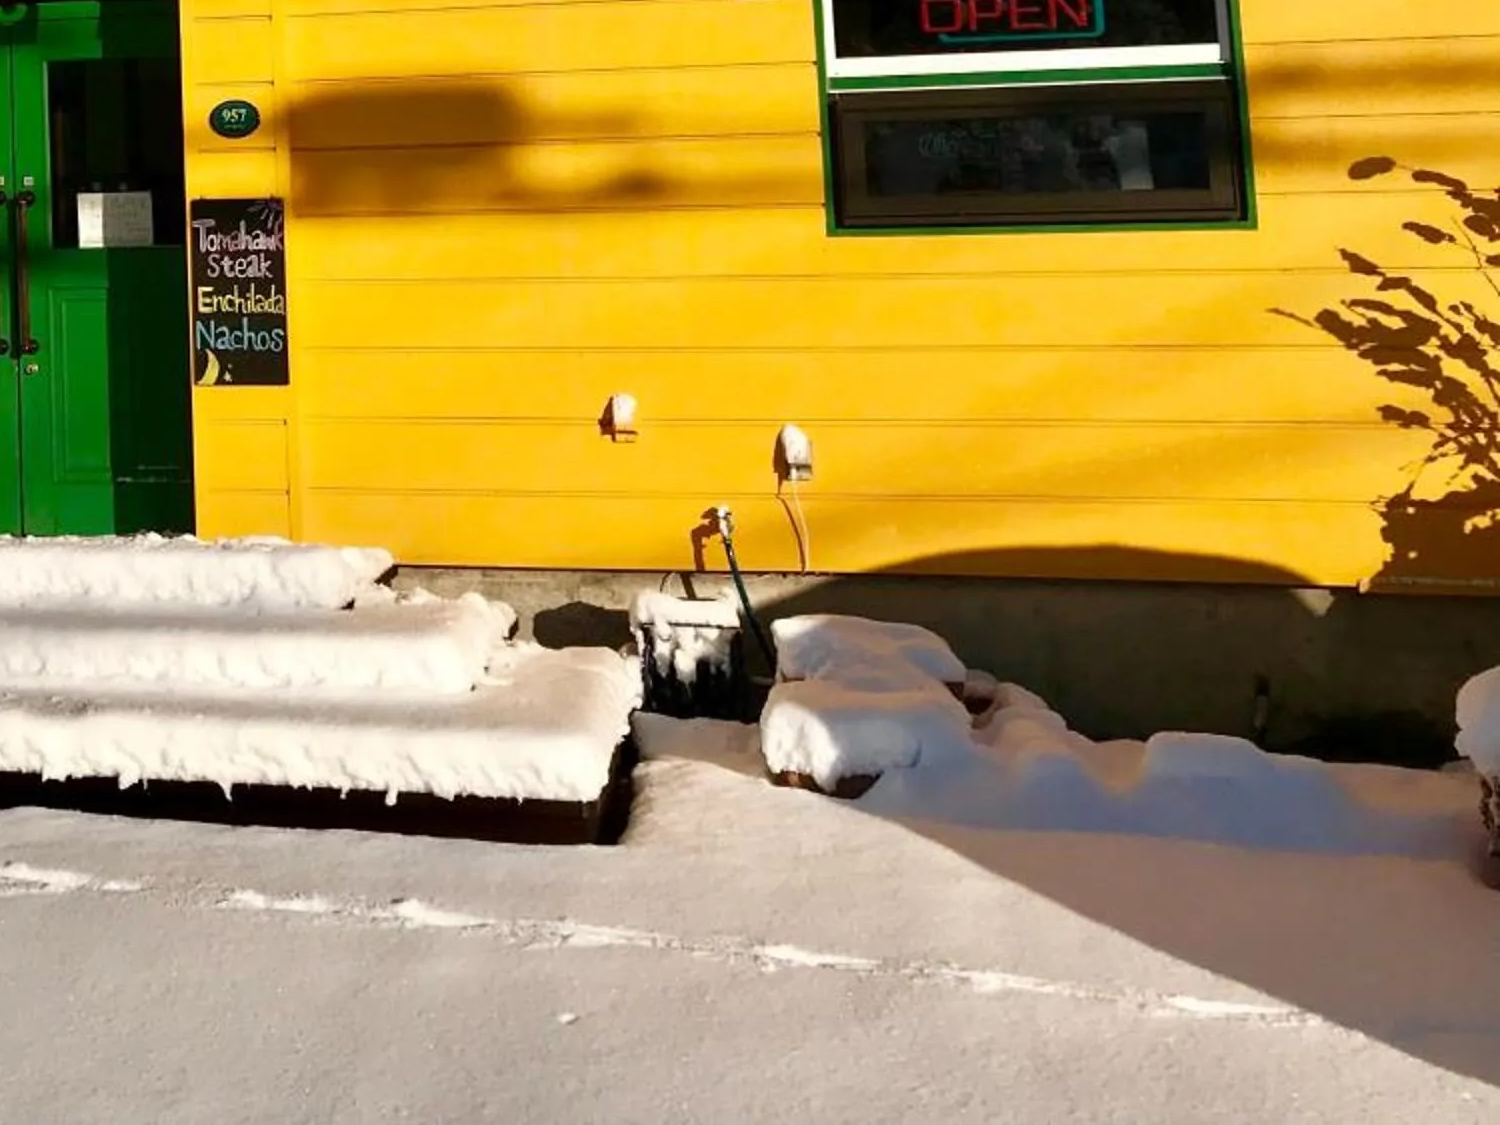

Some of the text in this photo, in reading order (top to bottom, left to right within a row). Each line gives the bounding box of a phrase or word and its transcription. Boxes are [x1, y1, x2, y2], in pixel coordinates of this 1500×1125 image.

[221, 108, 248, 124] 957
[206, 252, 274, 279] Steak
[197, 283, 285, 315] Enchilada
[195, 316, 285, 352] Nachos
